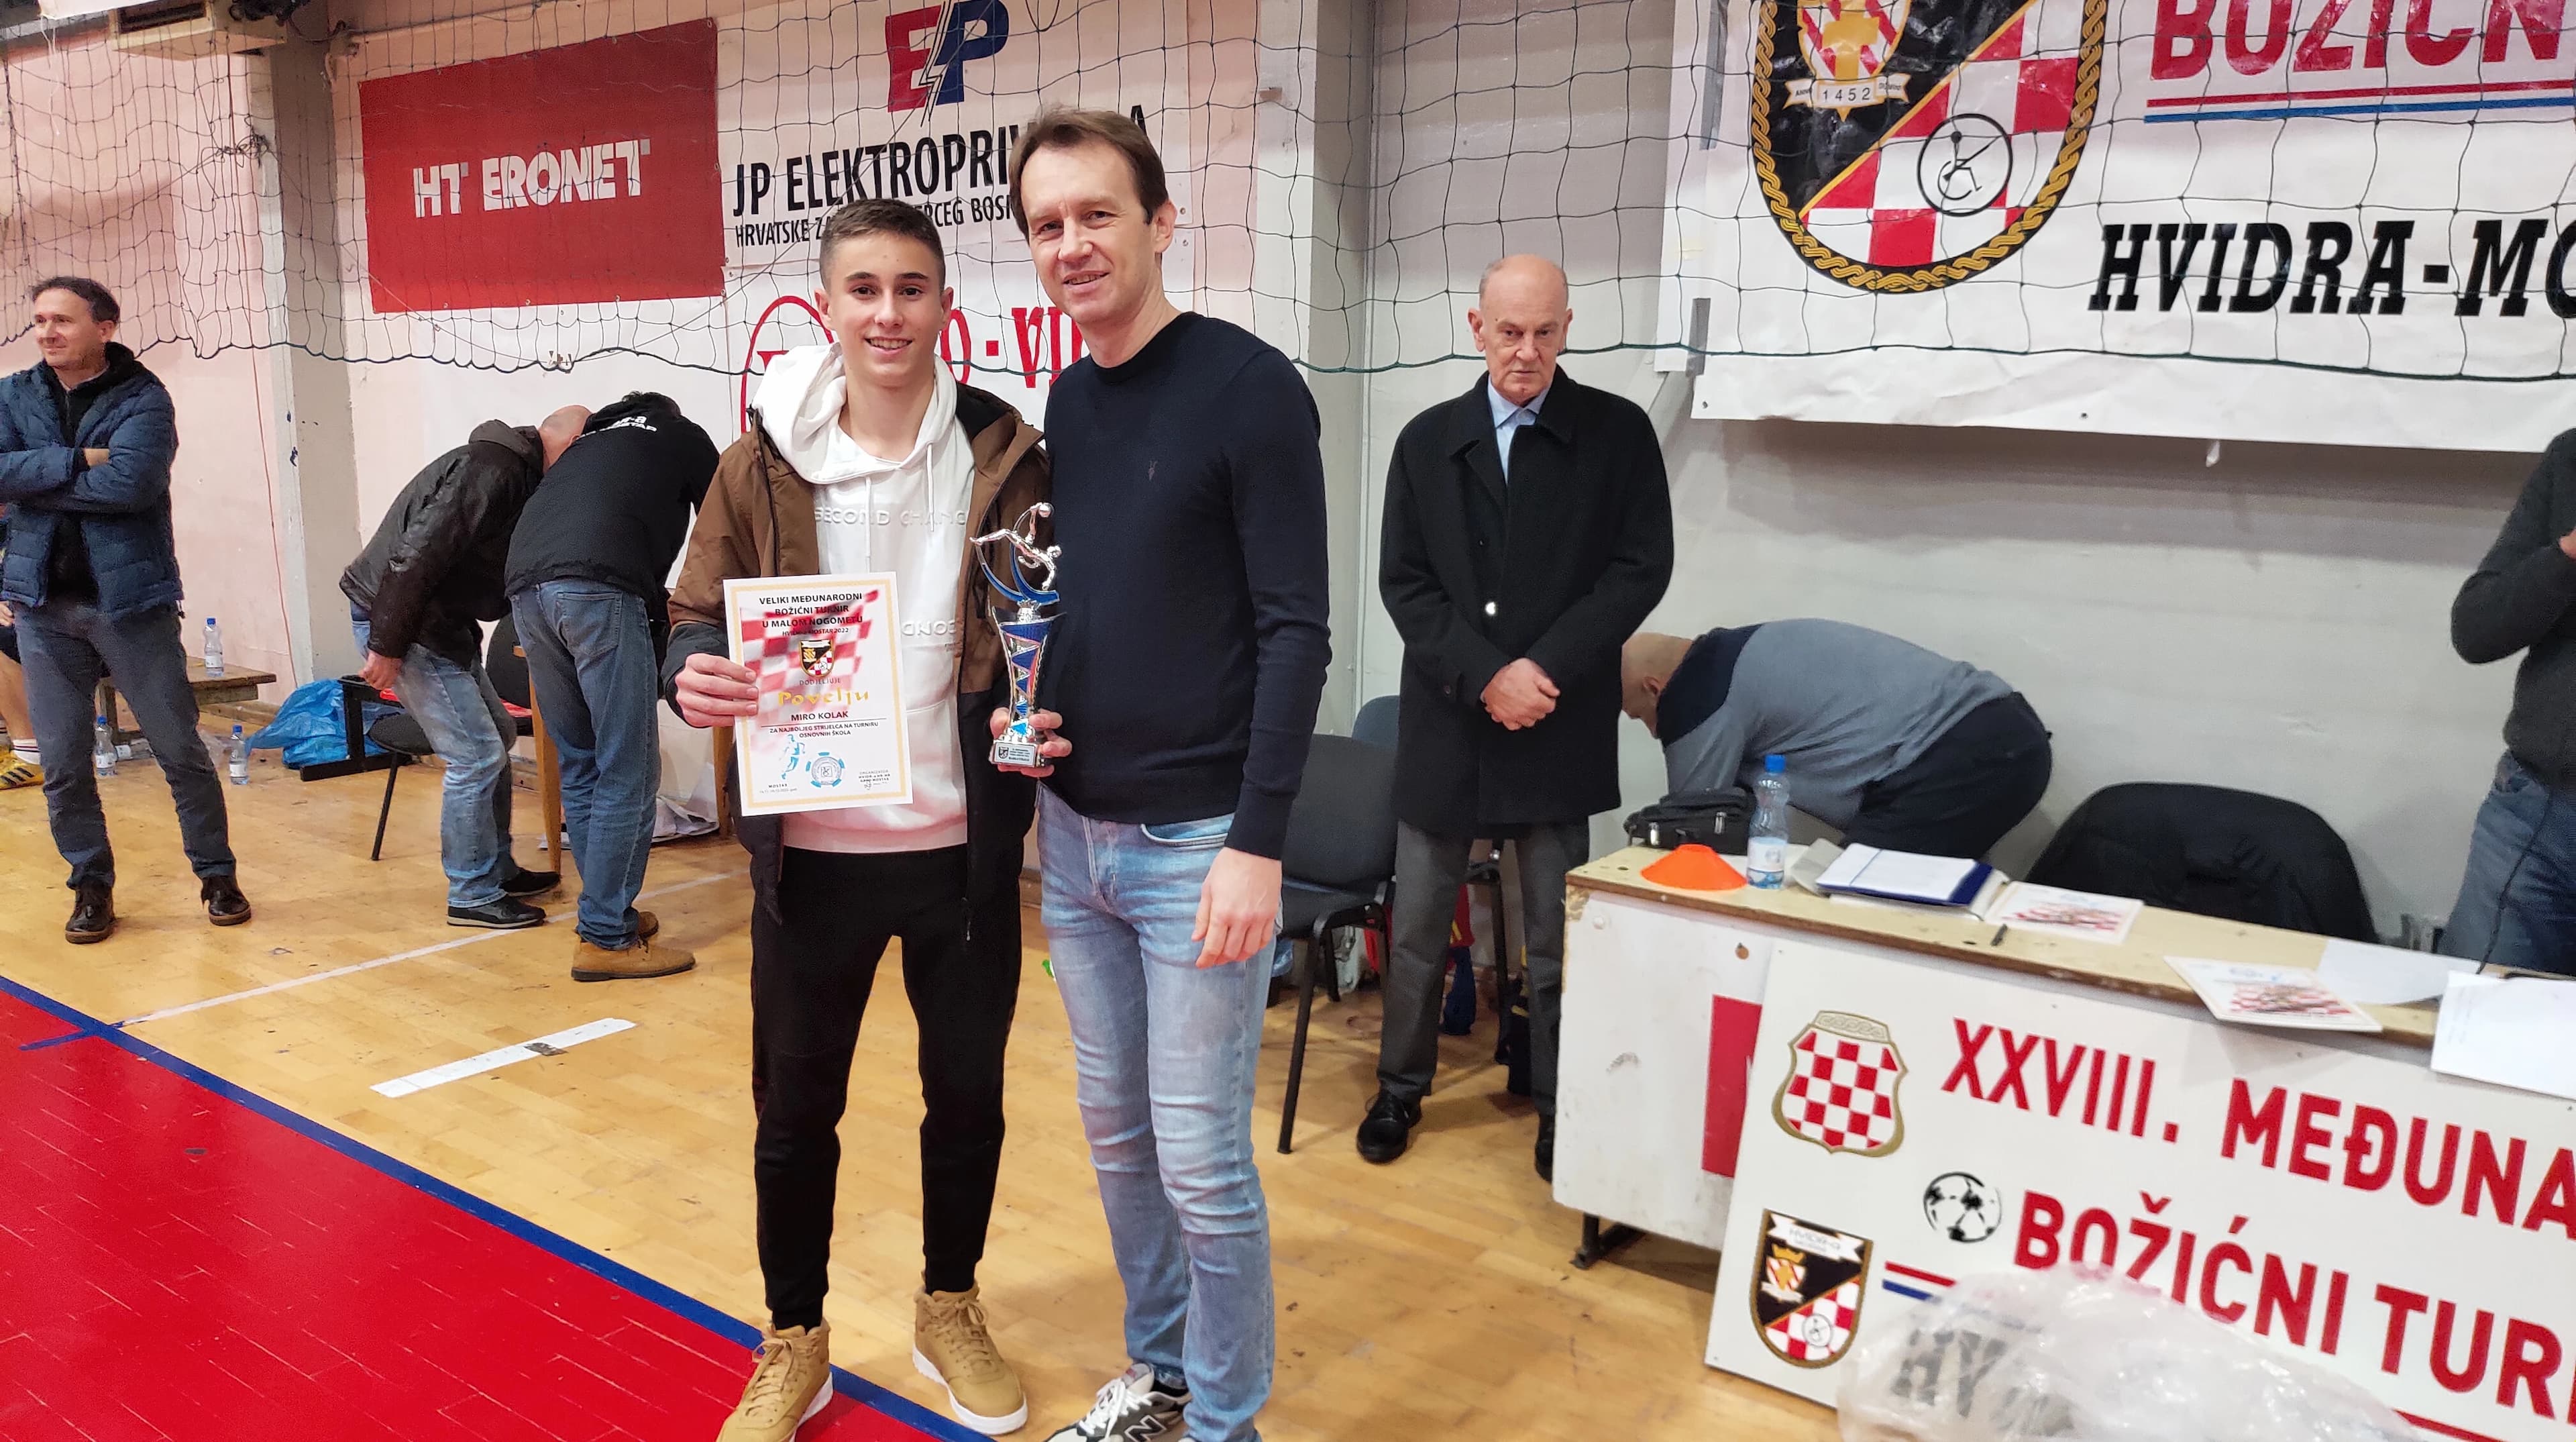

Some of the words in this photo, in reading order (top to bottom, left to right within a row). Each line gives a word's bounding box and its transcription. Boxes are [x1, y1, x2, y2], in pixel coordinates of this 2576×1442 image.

[413, 163, 464, 218] HT
[482, 139, 642, 212] ERONET
[733, 162, 770, 217] JP
[735, 219, 810, 248] HRVATSKE
[2088, 219, 2576, 319] HVIDRA-MO
[901, 510, 967, 526] CHANC
[759, 596, 789, 605] VELIKI
[792, 593, 863, 603] MEĐUNARODNI
[809, 615, 863, 626] NOGOMETU
[778, 686, 869, 706] Povelju
[791, 713, 816, 722] MIRO
[818, 711, 849, 719] KOLAK
[1941, 1017, 2180, 1143] XXVIII.
[2220, 1077, 2576, 1241] MEĐUNA
[2015, 1190, 2349, 1356] BOŽIĆNI
[2375, 1282, 2576, 1426] TUR
